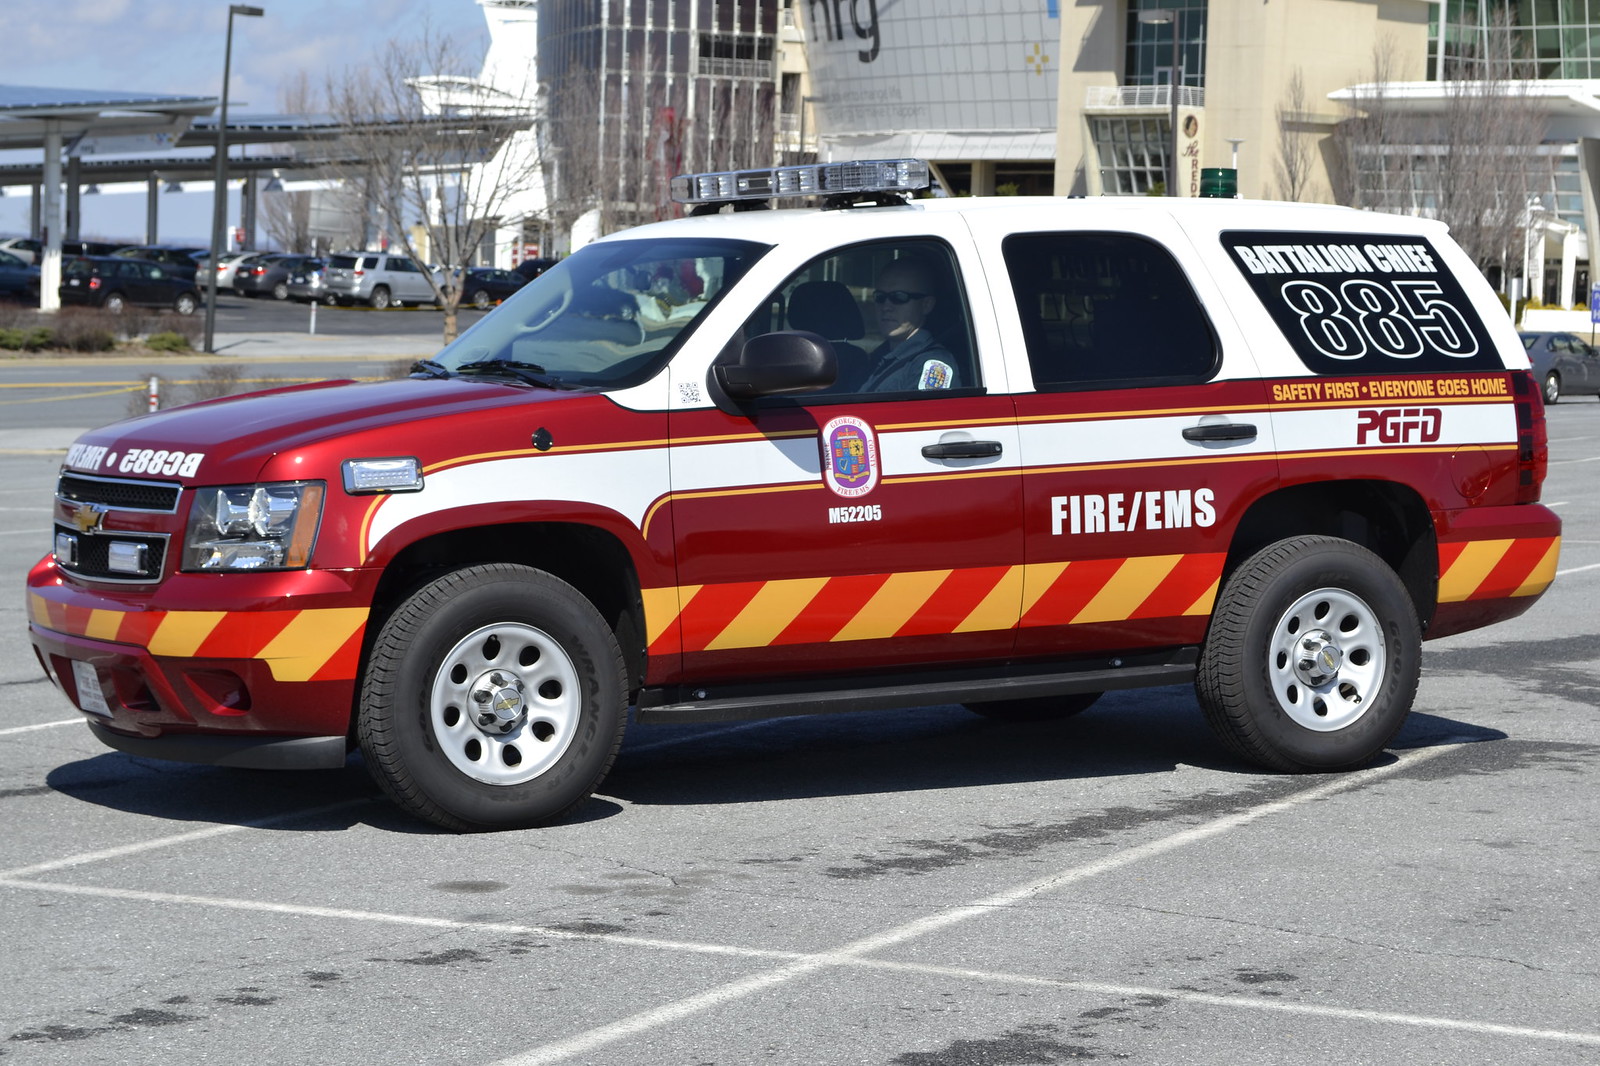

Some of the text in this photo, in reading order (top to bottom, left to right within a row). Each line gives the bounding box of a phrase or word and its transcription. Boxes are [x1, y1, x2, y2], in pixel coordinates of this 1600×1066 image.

[1181, 140, 1199, 158] the
[1233, 244, 1438, 274] BATTALION CHIEF
[1280, 279, 1479, 360] 885
[1272, 377, 1508, 401] SAFETY FIRST EVERYONE GOES HOME
[1357, 407, 1443, 446] PGFD
[836, 485, 870, 496] FIRE/EMS
[828, 504, 882, 524] M52205
[1051, 487, 1217, 536] FIRE/EMS
